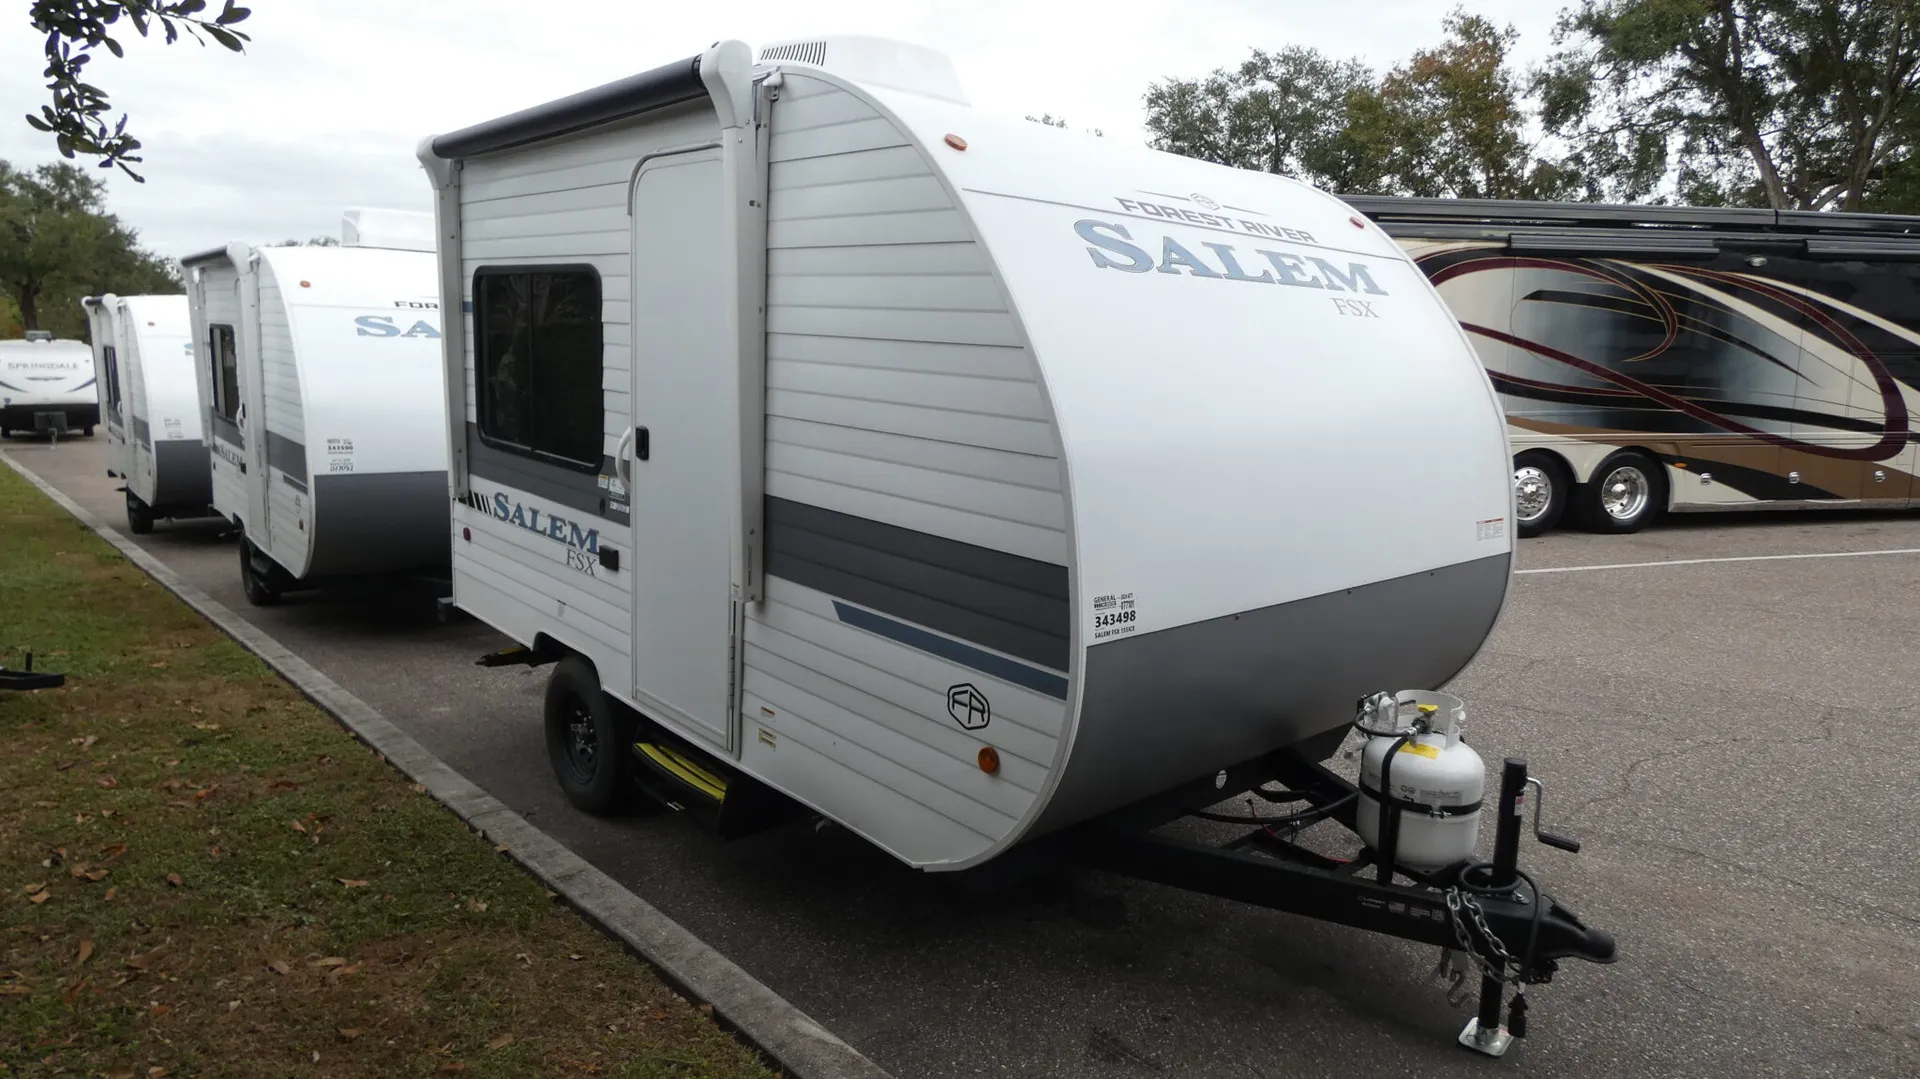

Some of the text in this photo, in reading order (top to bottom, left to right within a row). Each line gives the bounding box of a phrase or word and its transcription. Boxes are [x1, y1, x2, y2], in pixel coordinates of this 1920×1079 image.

[1113, 196, 1235, 230] FOREST
[1243, 219, 1318, 243] RIVER
[1073, 218, 1390, 297] SALEM
[1329, 296, 1381, 319] FSX
[7, 362, 79, 371] SPRINGDALE
[493, 491, 600, 556] SALEM
[565, 548, 598, 577] FSX
[1094, 594, 1116, 603] GENERAL
[1095, 610, 1136, 628] 343498
